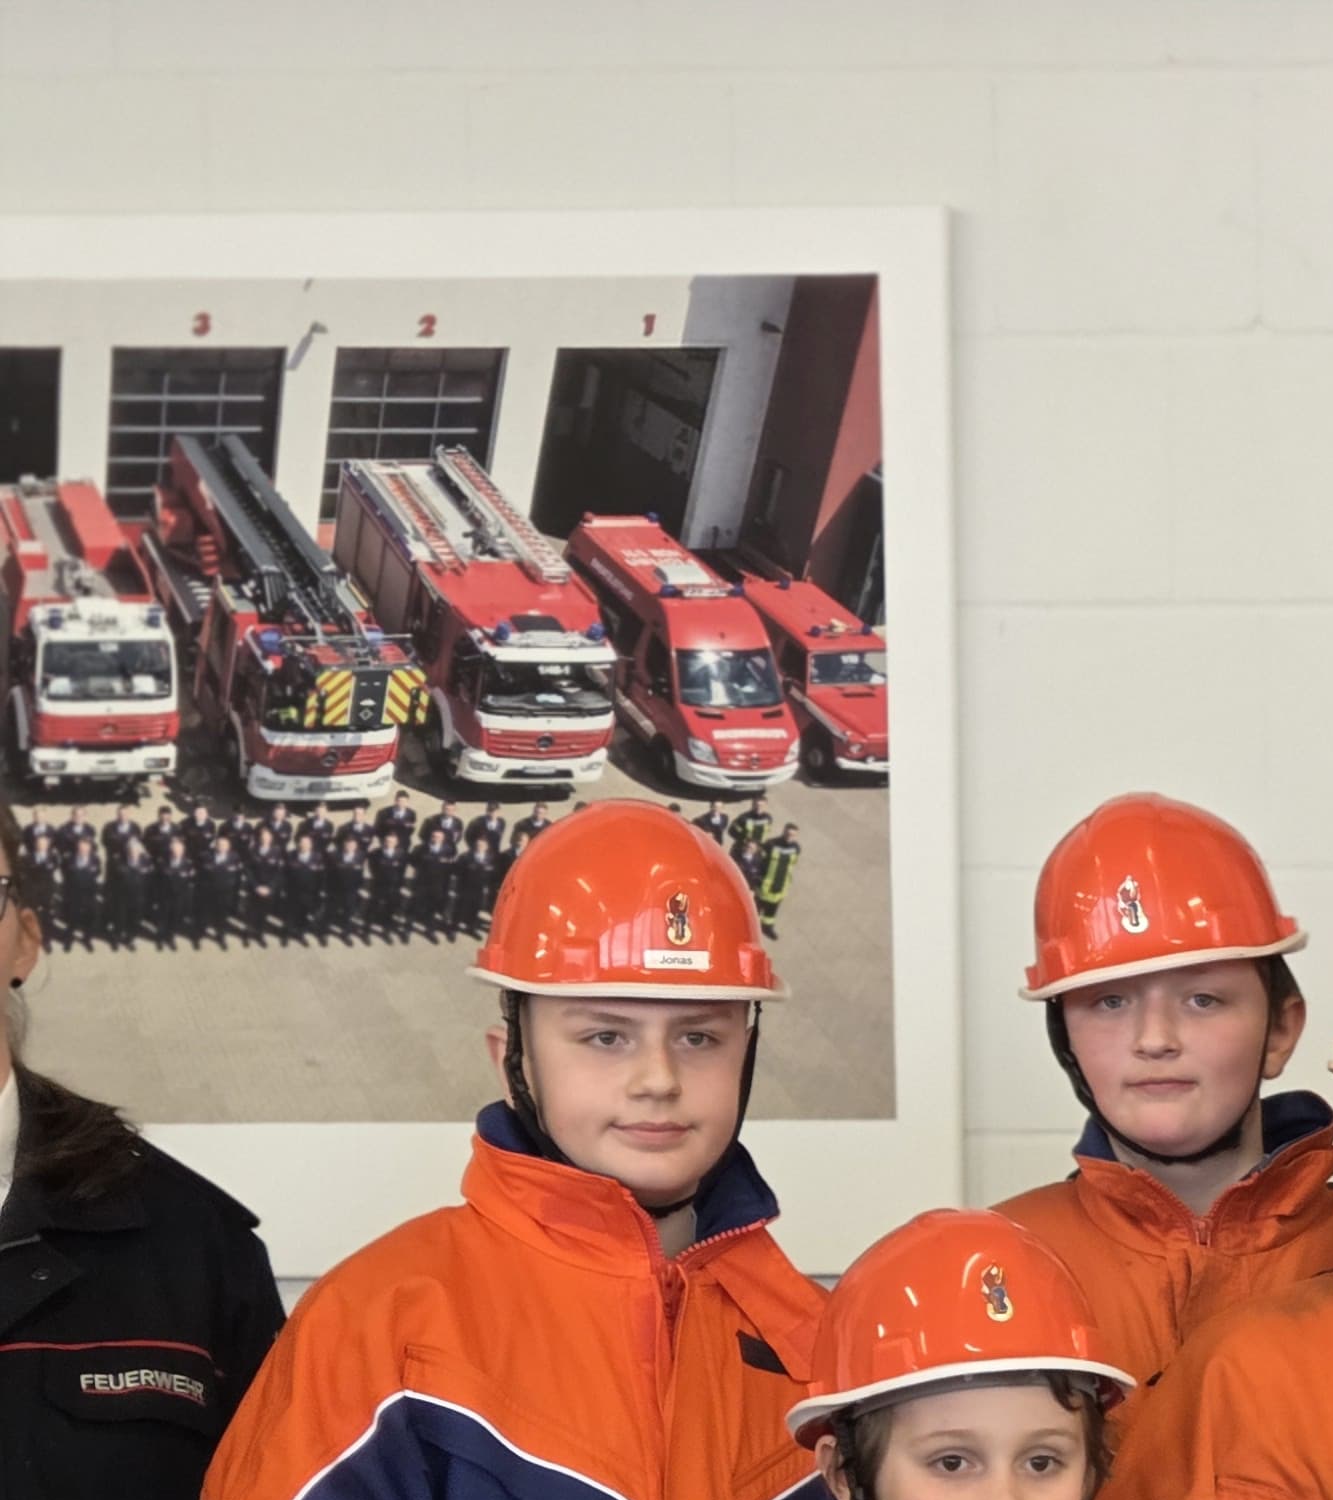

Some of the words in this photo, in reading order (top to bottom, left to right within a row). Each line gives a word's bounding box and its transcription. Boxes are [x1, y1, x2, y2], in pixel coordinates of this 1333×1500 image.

[192, 312, 211, 337] 3
[417, 314, 437, 338] 2
[643, 314, 656, 337] 1
[659, 955, 693, 965] Jonas
[80, 1368, 204, 1400] FEUERWEHR
